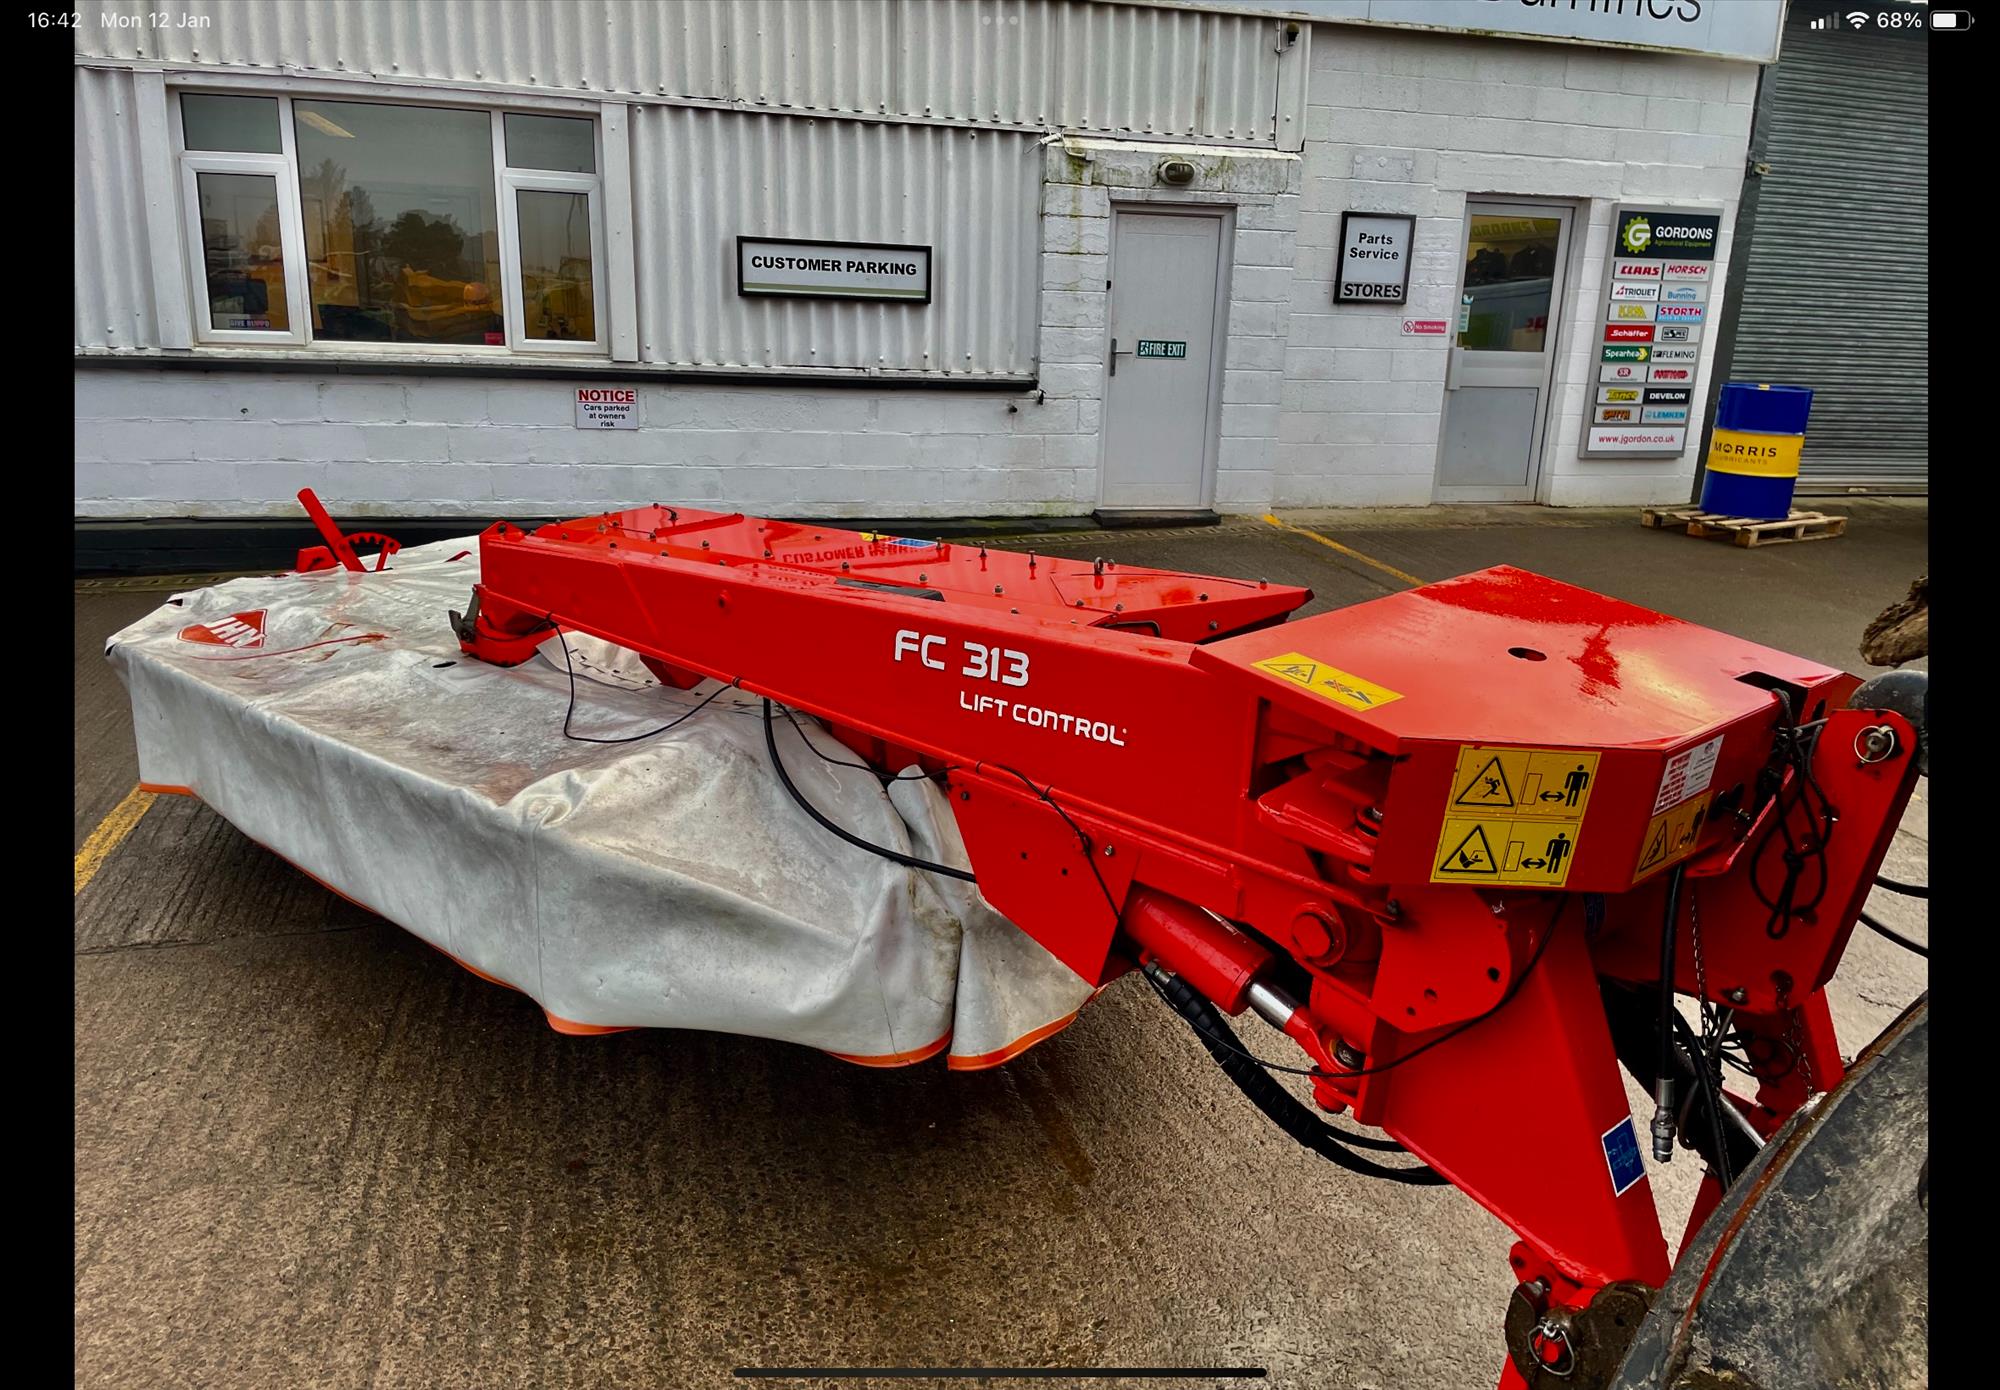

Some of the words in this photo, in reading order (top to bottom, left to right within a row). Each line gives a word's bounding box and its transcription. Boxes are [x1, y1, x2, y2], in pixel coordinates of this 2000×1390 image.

[1358, 232, 1393, 245] Parts
[1655, 226, 1713, 240] GORDONS
[1349, 247, 1399, 260] Service
[751, 255, 842, 272] CUSTOMER
[846, 260, 917, 276] PARKING
[1620, 265, 1661, 276] CLAAS
[1667, 265, 1708, 275] HORSCH
[1343, 283, 1402, 298] STORES
[1624, 287, 1657, 297] TRIOLIET
[1667, 290, 1697, 301] Bunning
[1660, 306, 1702, 316] STORTH
[1424, 324, 1445, 332] Smoking
[1149, 342, 1166, 356] FIRE
[1167, 343, 1185, 357] EXIT
[1661, 350, 1695, 359] FLEMING
[578, 389, 635, 402] NOTICE
[1649, 392, 1686, 400] DEVELON
[1598, 434, 1675, 446] www.jgordon.co.uk
[1713, 441, 1778, 458] MORRIS
[894, 629, 948, 671] FC
[962, 640, 1030, 688] 313
[959, 690, 1009, 718] LIFT
